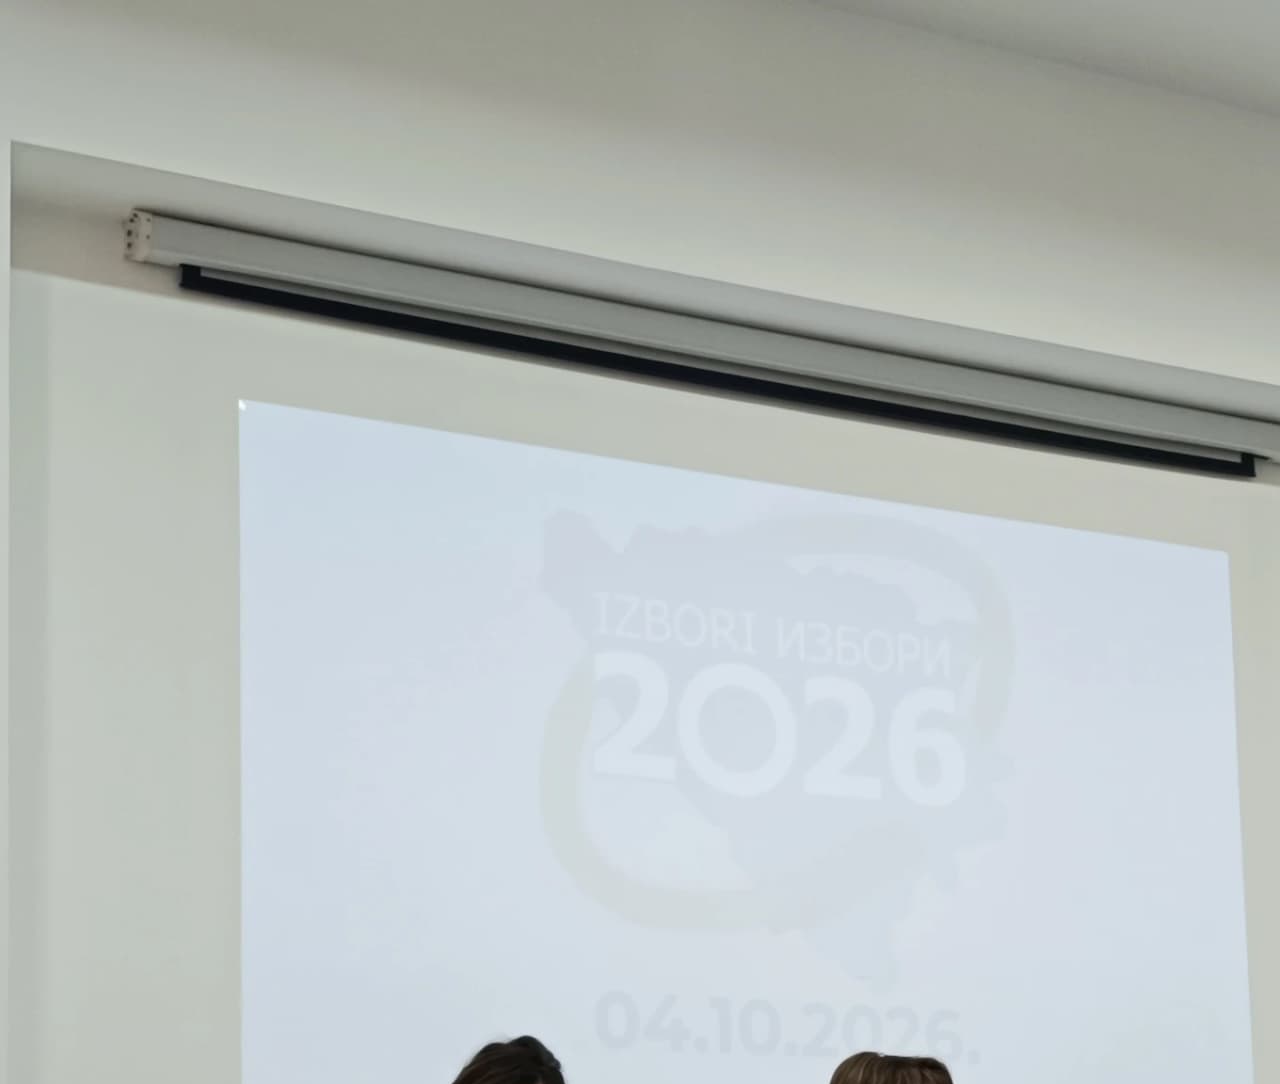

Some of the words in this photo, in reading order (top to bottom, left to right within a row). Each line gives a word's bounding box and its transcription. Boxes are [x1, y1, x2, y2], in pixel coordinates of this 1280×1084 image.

[592, 591, 757, 655] IZBORI
[777, 619, 953, 678] ИЗБОРИ
[591, 651, 967, 806] 2026
[595, 989, 980, 1064] 04.10.2026.
